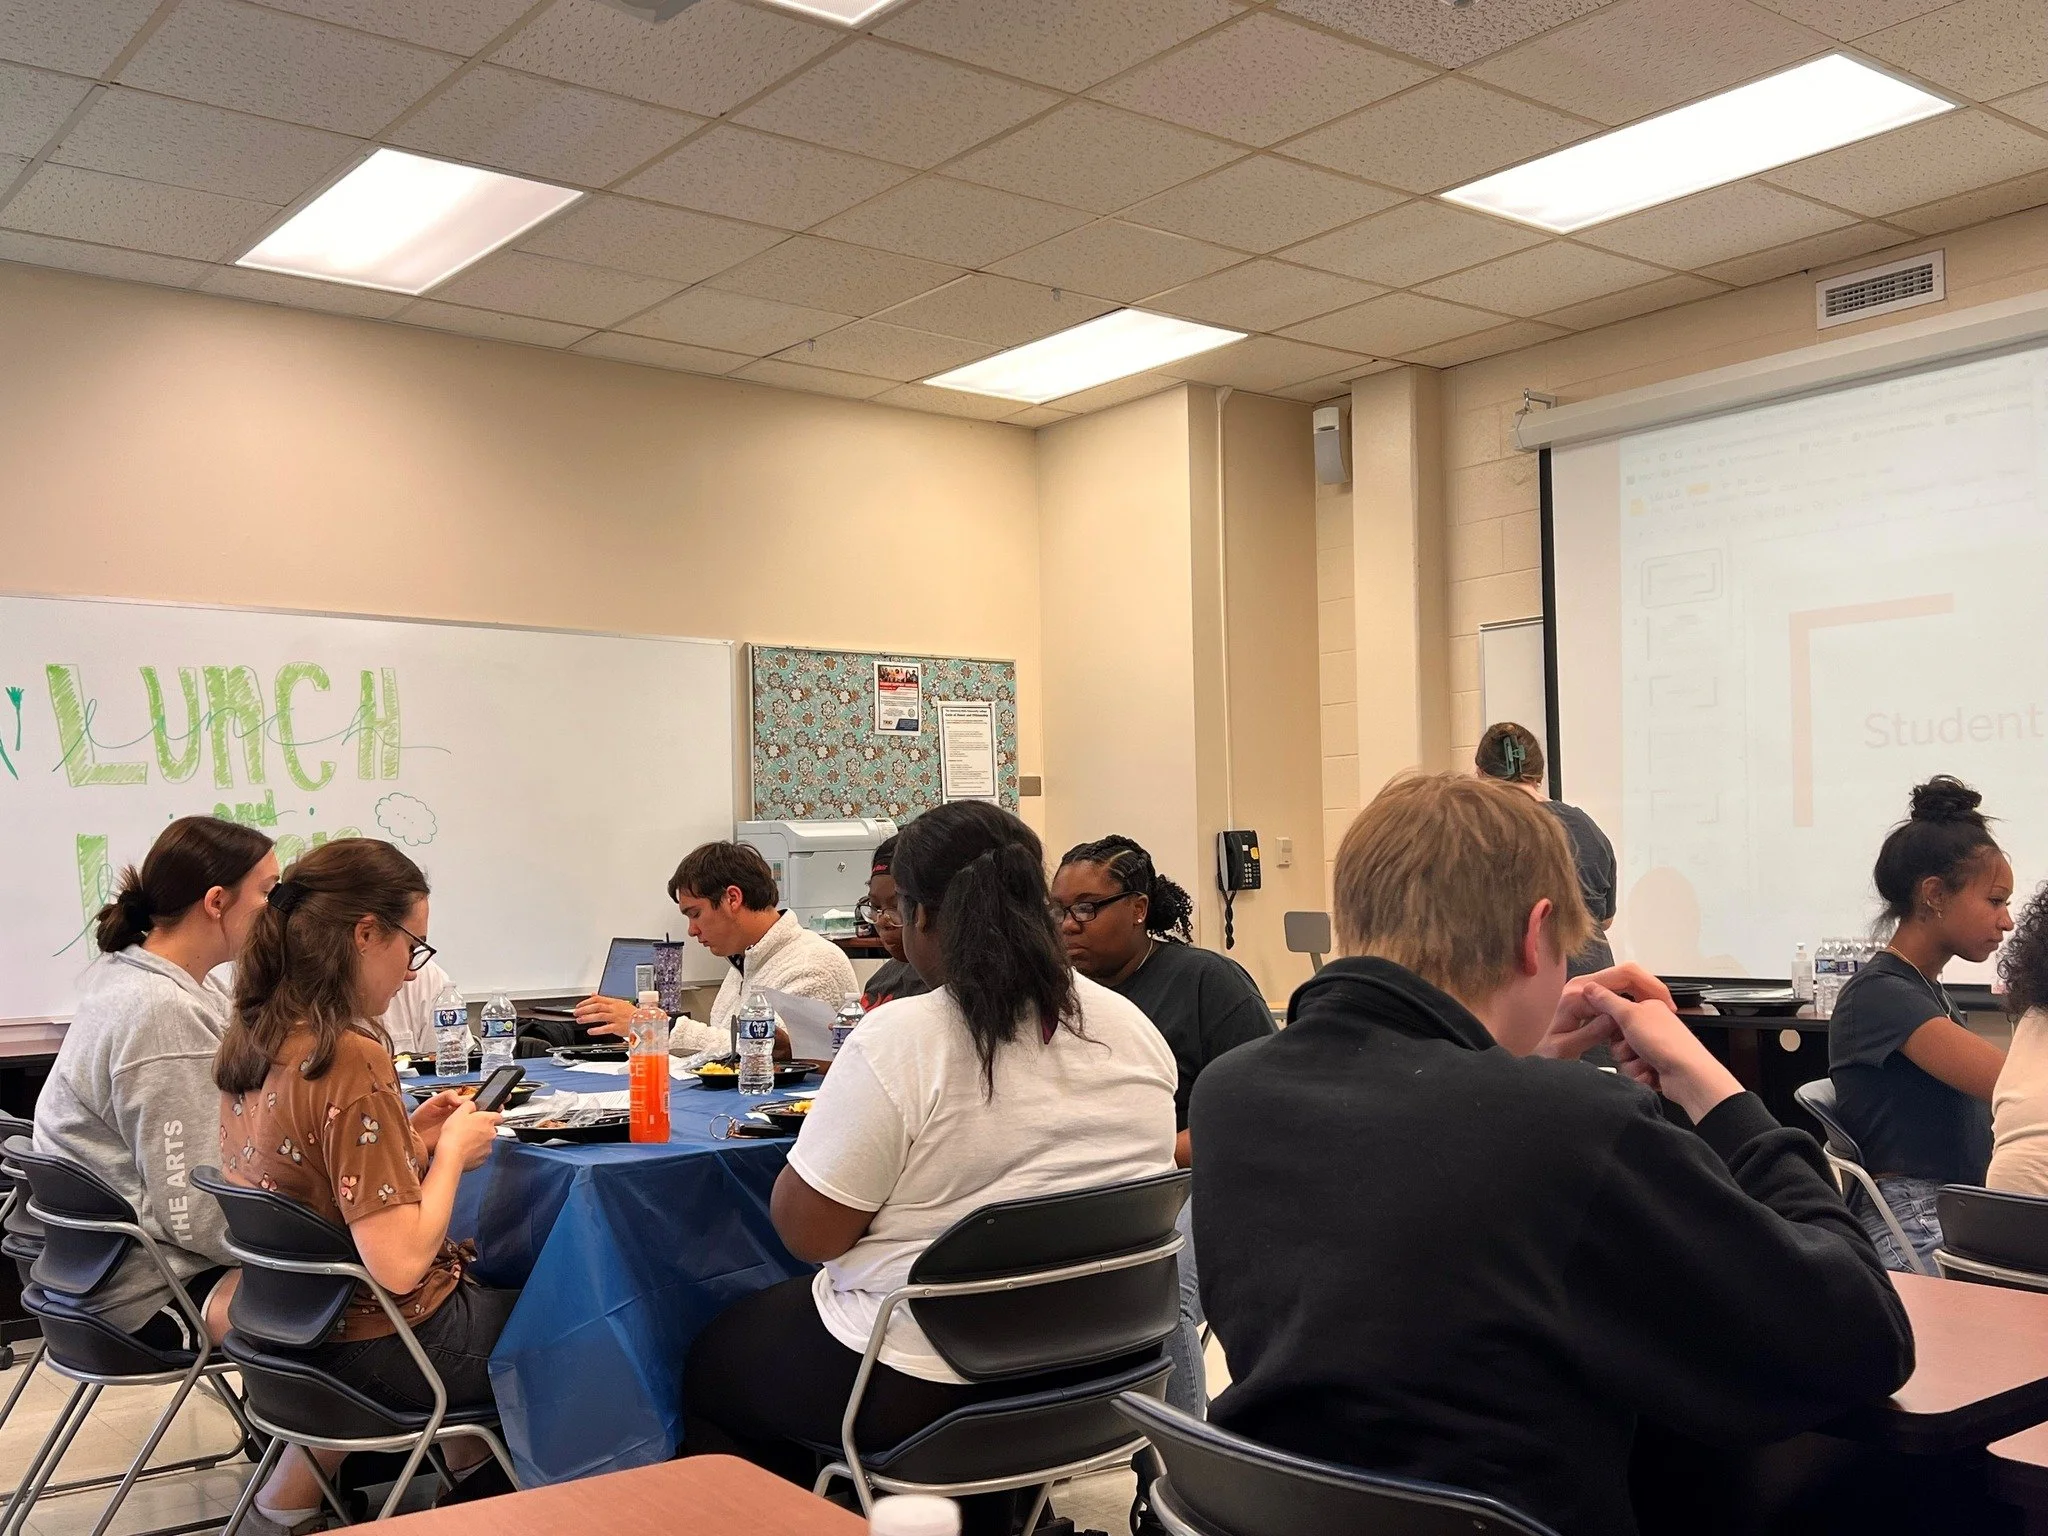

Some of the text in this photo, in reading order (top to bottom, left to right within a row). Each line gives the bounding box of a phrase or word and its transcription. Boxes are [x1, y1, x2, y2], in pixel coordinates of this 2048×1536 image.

[46, 661, 401, 791] LUNCH
[1864, 703, 2045, 748] Student
[213, 789, 278, 827] and
[163, 1119, 193, 1244] THE ARTS
